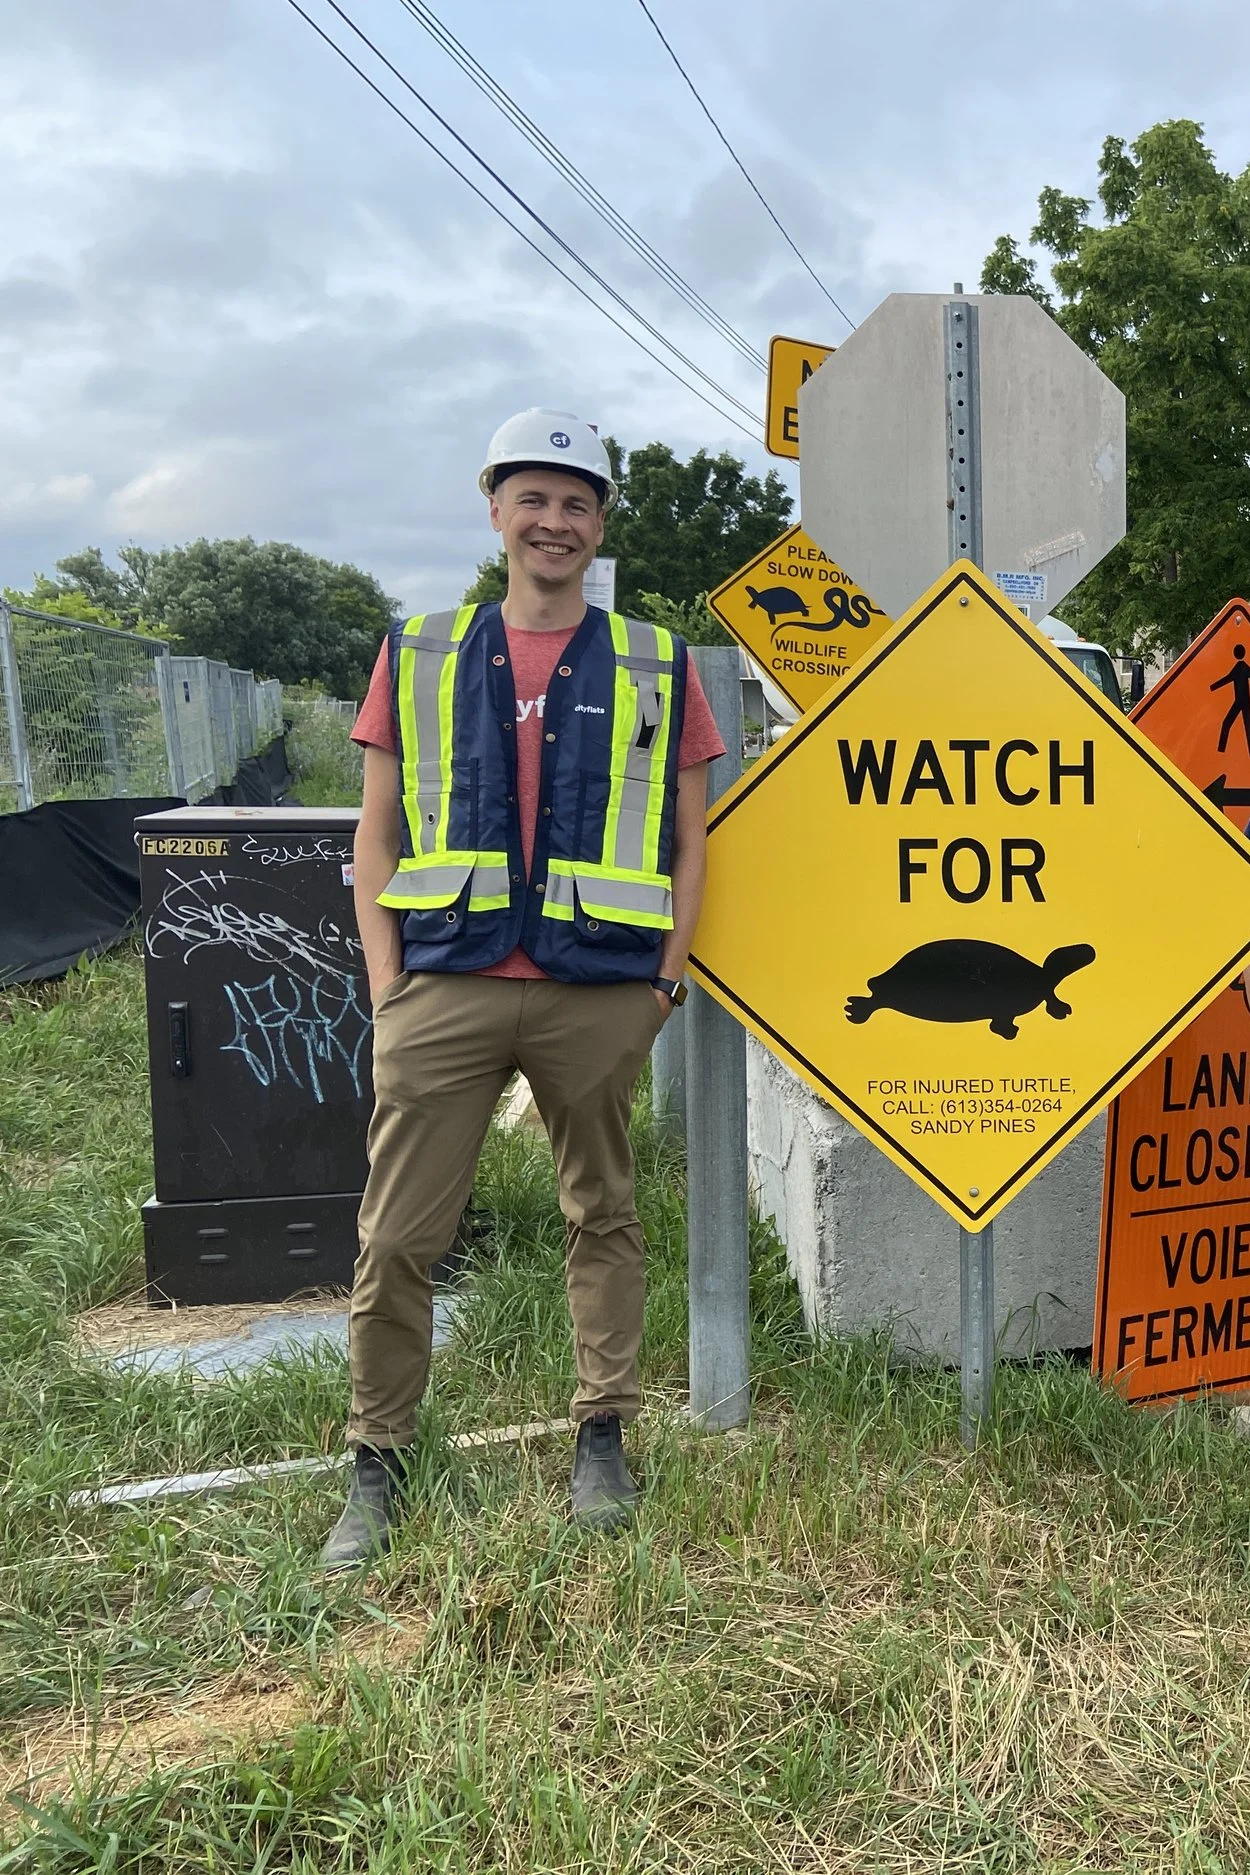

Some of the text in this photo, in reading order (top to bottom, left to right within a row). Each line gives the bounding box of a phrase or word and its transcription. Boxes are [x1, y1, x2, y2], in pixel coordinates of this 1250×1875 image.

[787, 545, 836, 565] PLEA
[767, 561, 858, 586] SLOW DOW
[775, 638, 847, 659] WILDLIFE
[837, 739, 1095, 806] WATCH
[143, 838, 229, 855] FC2206A
[898, 837, 1046, 904] FOR
[868, 1078, 1076, 1095] FOR INJURED TURTLE,
[882, 1098, 1063, 1117] CALL: (613)354-0264
[910, 1118, 1036, 1134] SANDY PINES
